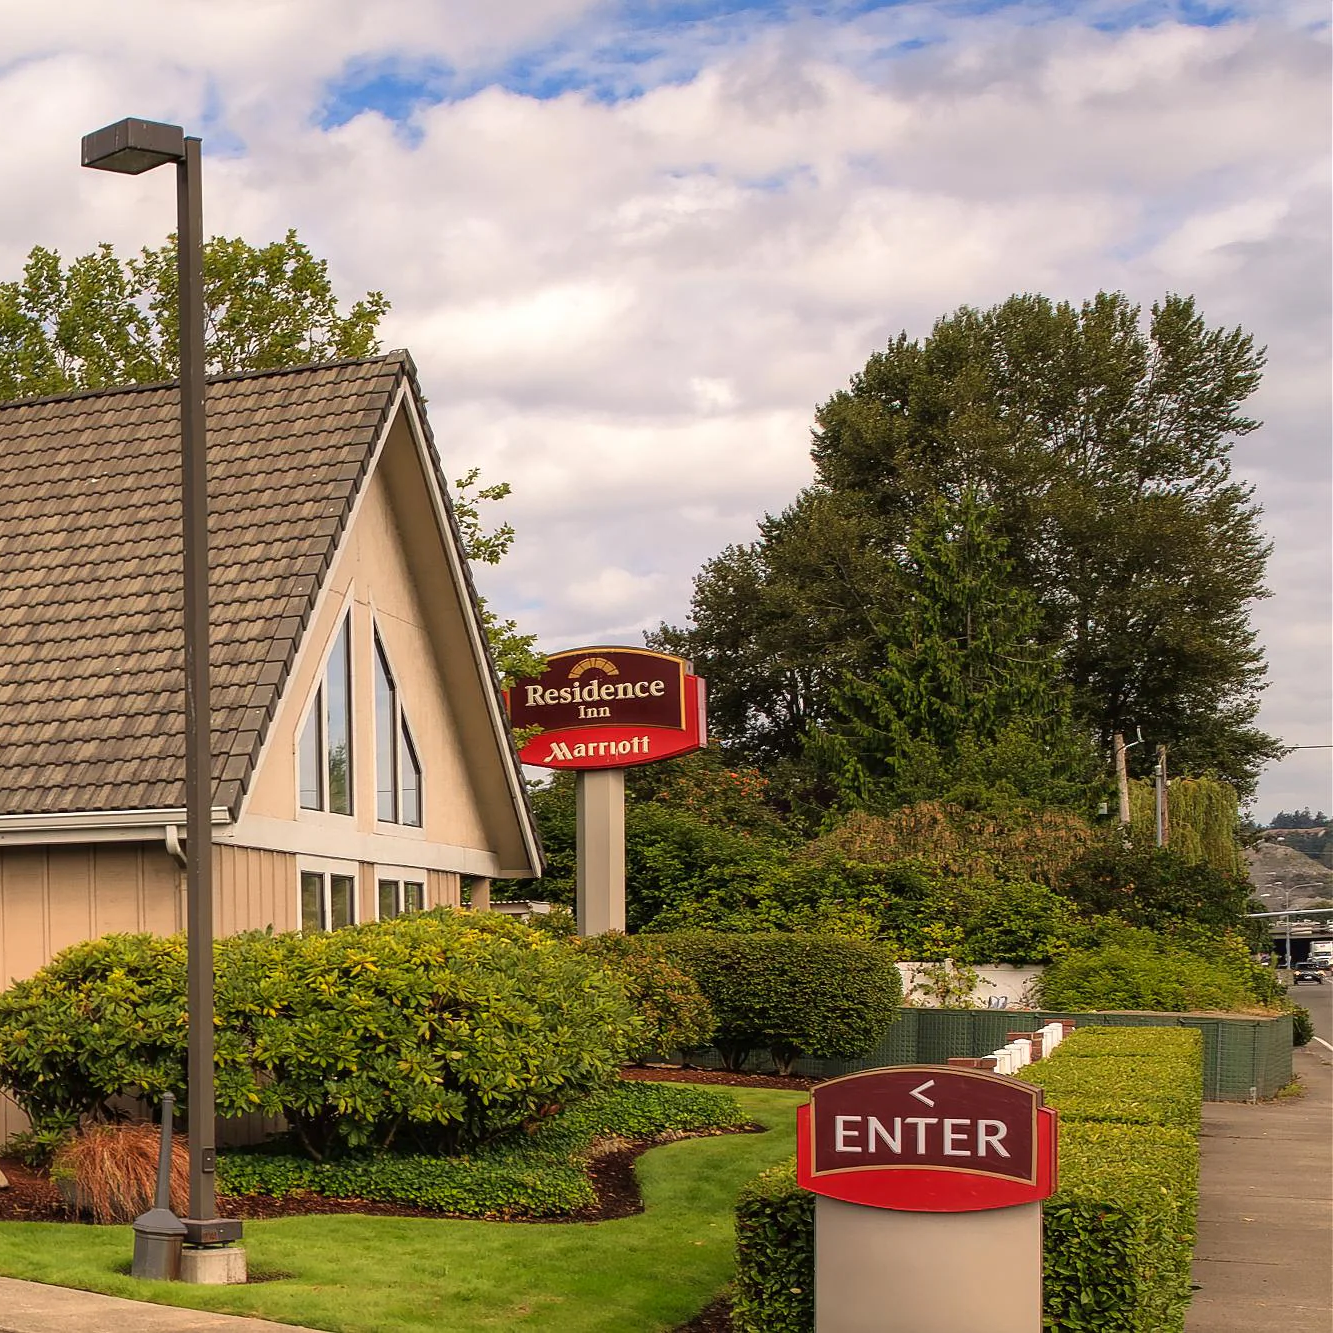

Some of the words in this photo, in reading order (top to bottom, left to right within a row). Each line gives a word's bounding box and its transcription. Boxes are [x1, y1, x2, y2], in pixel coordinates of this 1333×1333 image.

[525, 679, 665, 707] Residence
[578, 705, 611, 719] Inn
[543, 735, 650, 763] Marriott
[835, 1115, 1011, 1158] ENTER
